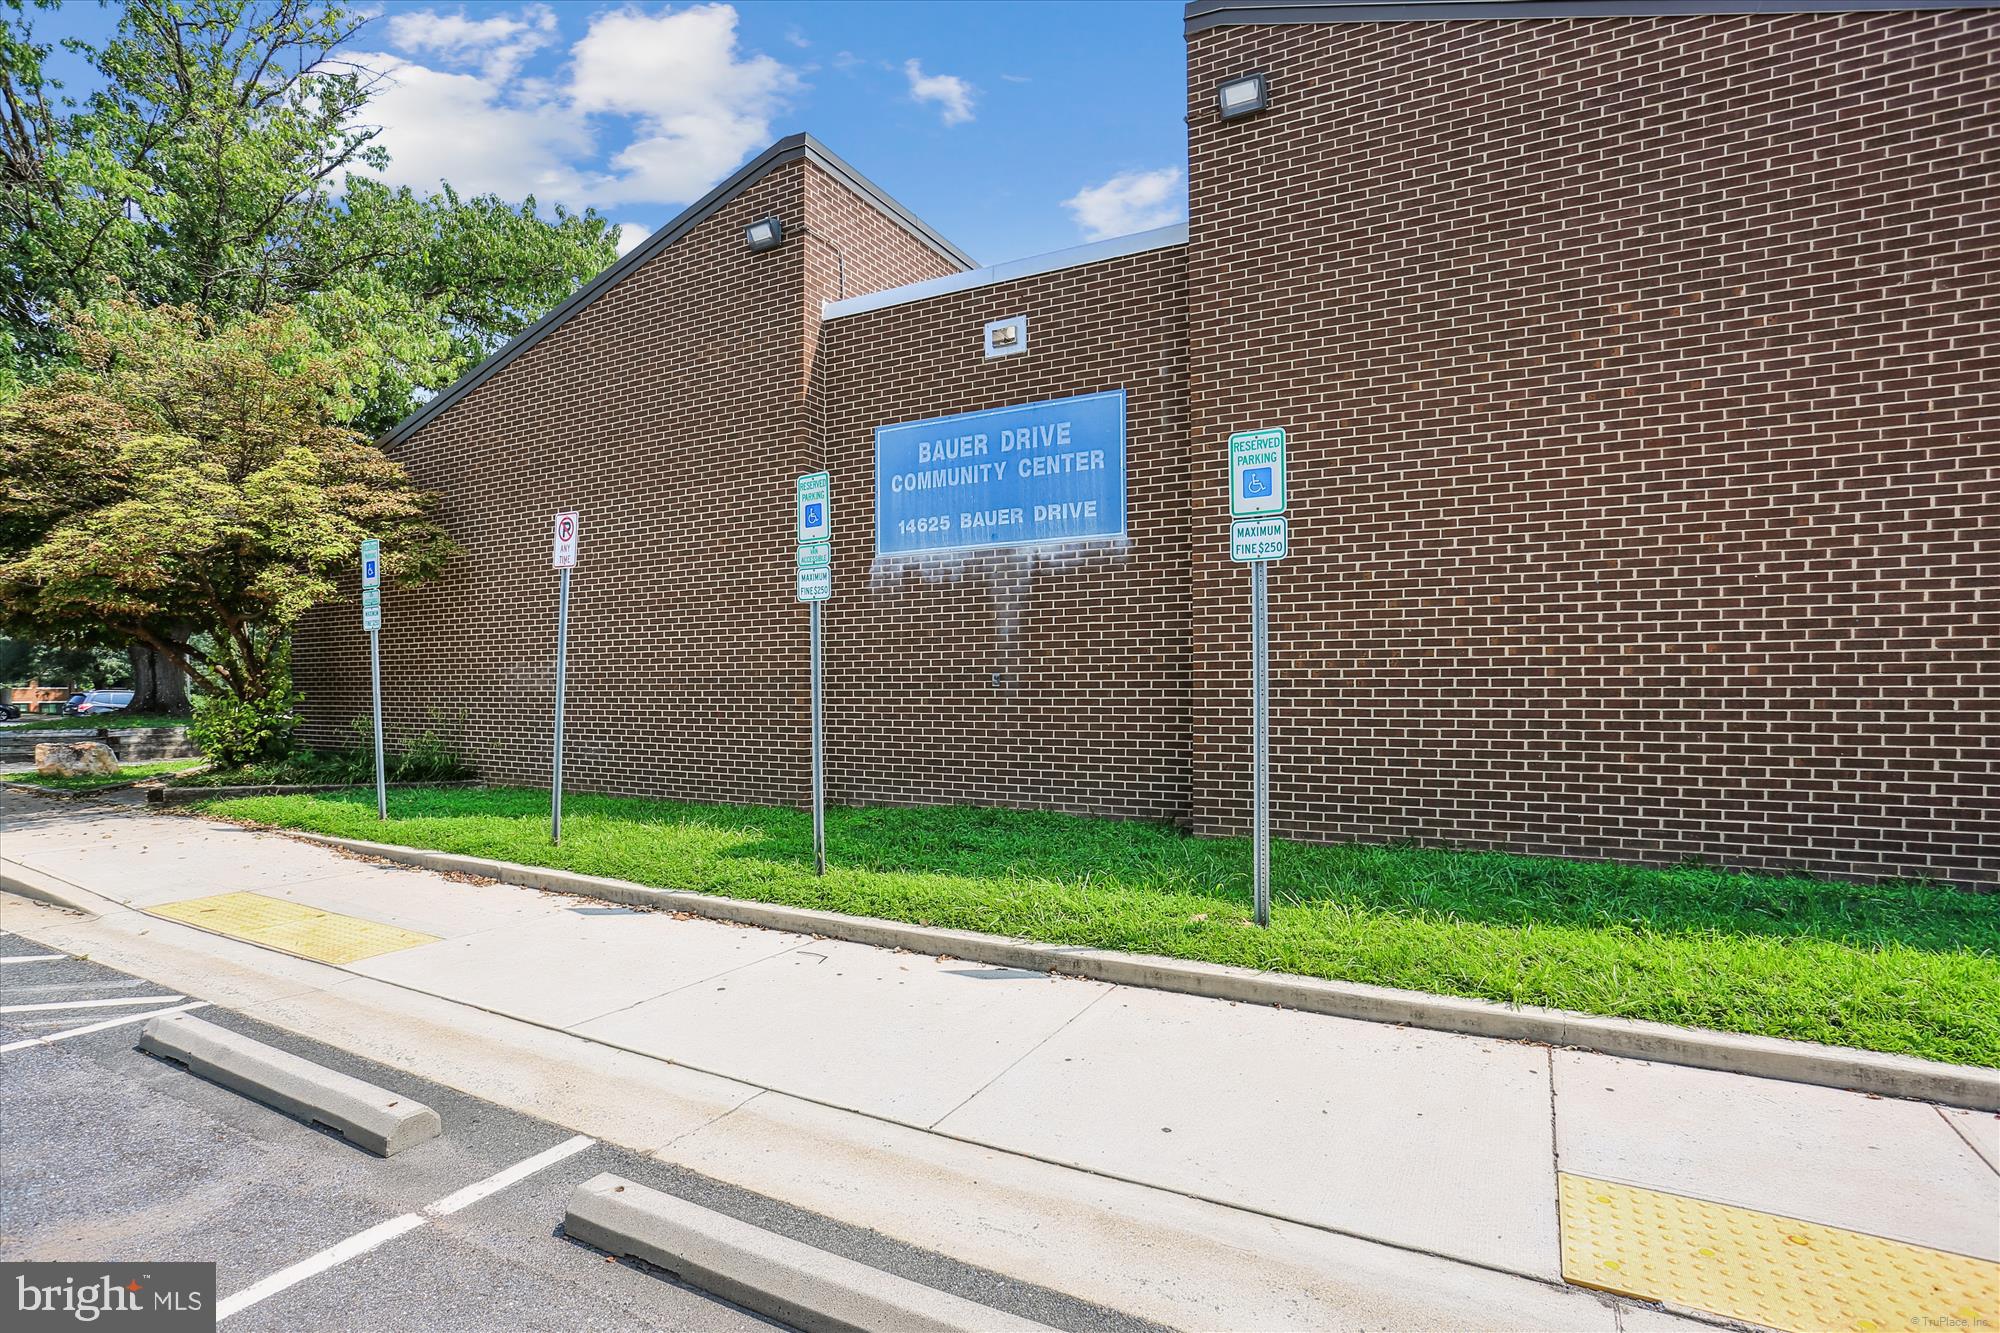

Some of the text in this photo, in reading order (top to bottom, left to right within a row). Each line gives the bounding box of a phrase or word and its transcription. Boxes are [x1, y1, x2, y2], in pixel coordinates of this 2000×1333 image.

[918, 421, 1072, 464] BAUER DRIVE
[1233, 437, 1280, 453] RESERVED
[1237, 452, 1277, 466] PARKING
[891, 449, 1105, 493] COMMUNITY CENTER
[800, 479, 826, 491] RESERVED
[801, 490, 825, 502] PARKING
[898, 500, 1098, 535] 14625 BAUER DRIVE
[1237, 525, 1281, 538] MAXIMUM
[561, 544, 570, 552] ANY
[559, 555, 571, 564] TIME
[801, 572, 828, 582] MAXIMUM
